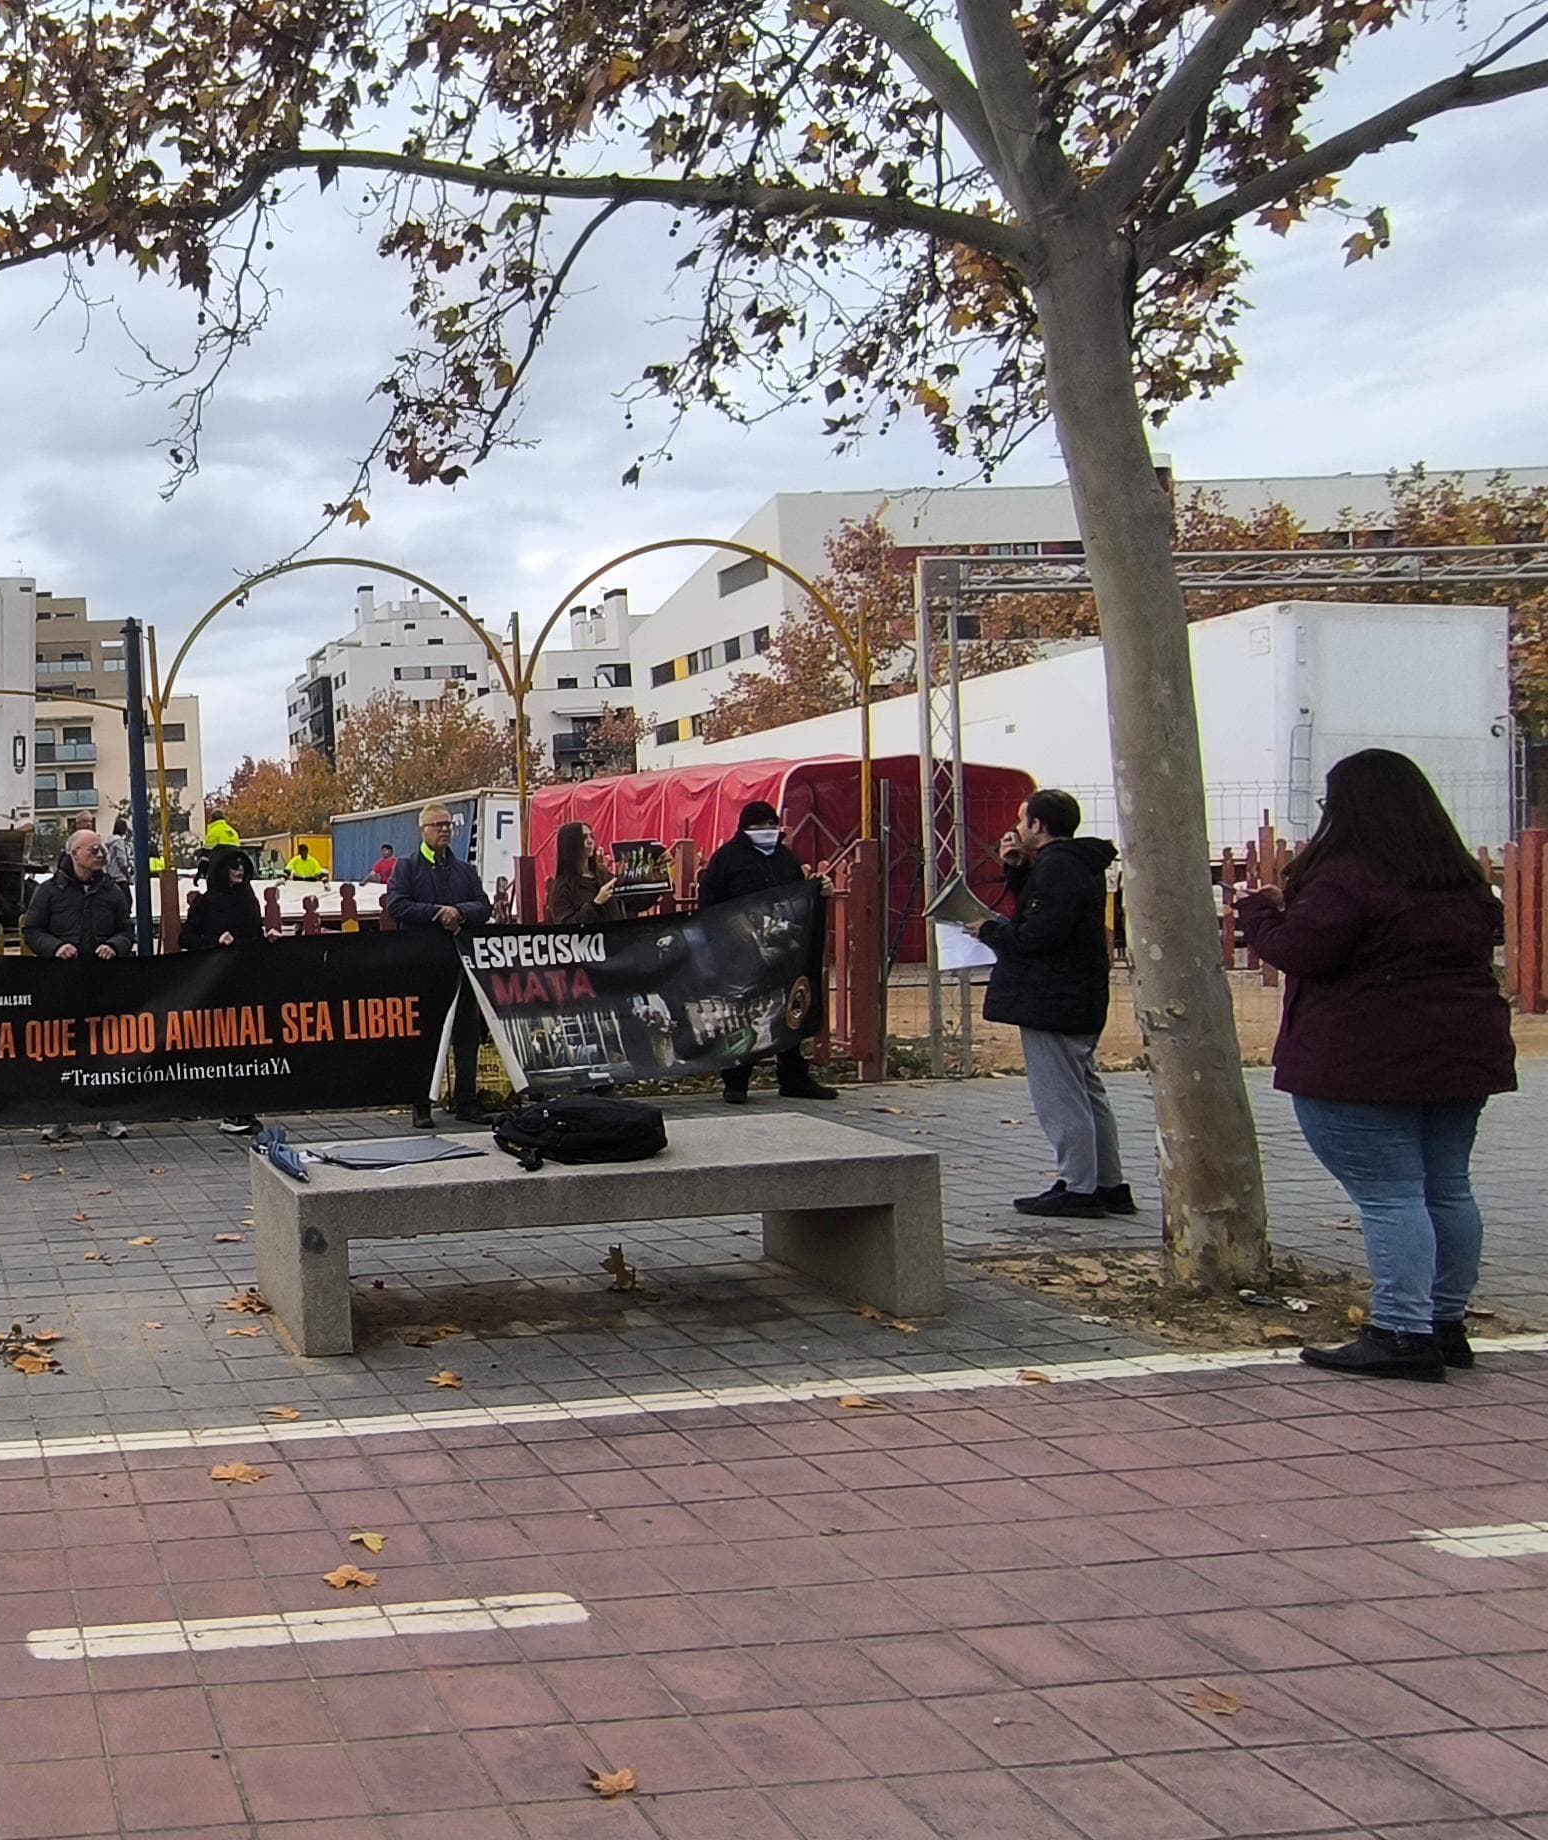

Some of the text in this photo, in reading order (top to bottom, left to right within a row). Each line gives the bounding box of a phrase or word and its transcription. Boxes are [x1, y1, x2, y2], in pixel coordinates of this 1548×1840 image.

[496, 810, 514, 840] F
[472, 932, 607, 969] ESPECISMO
[490, 968, 597, 1006] MATA
[24, 1018, 77, 1062] QUE
[84, 1012, 156, 1056] TODO
[165, 1005, 274, 1052] ANIMAL
[280, 1000, 335, 1044] SEA
[342, 996, 421, 1040] LIBRE
[60, 1057, 292, 1087] #TransiciónAlimentariaYA
